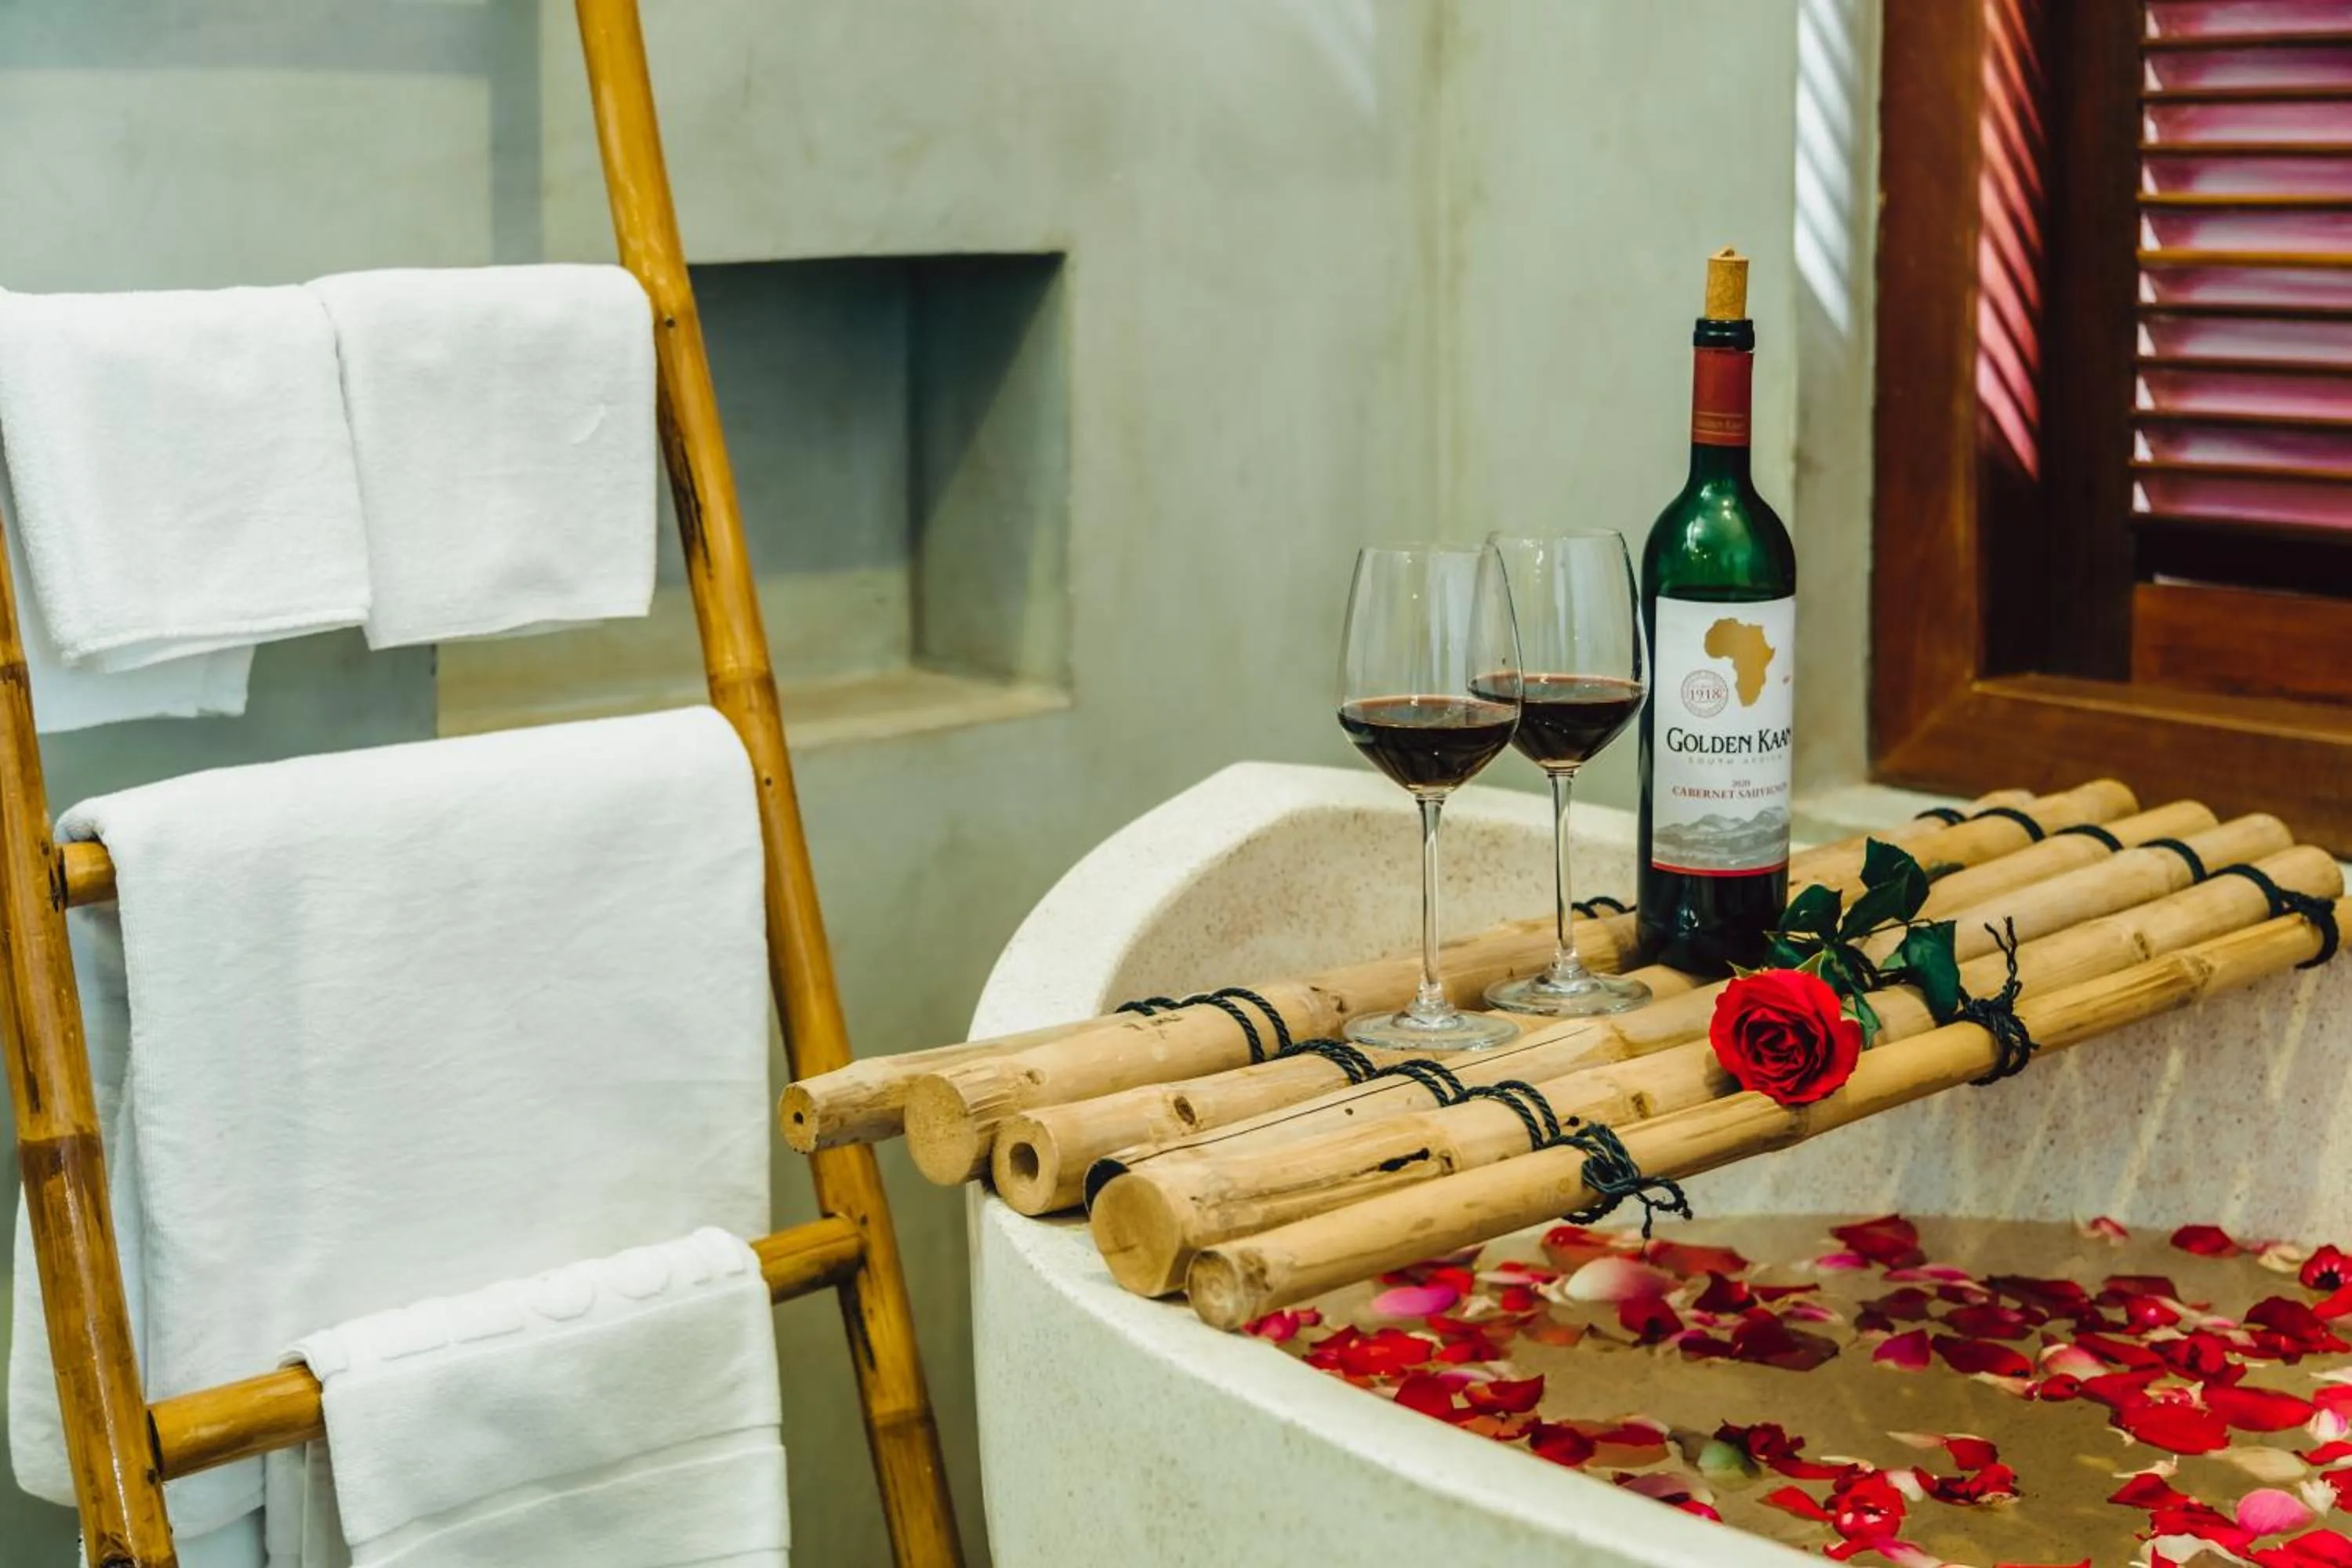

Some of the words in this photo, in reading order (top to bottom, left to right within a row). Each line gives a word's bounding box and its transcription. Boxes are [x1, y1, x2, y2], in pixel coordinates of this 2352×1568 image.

[1691, 689, 1722, 700] 1918
[1667, 727, 1752, 753] GOLDEN
[1672, 785, 1733, 799] CABERNET
